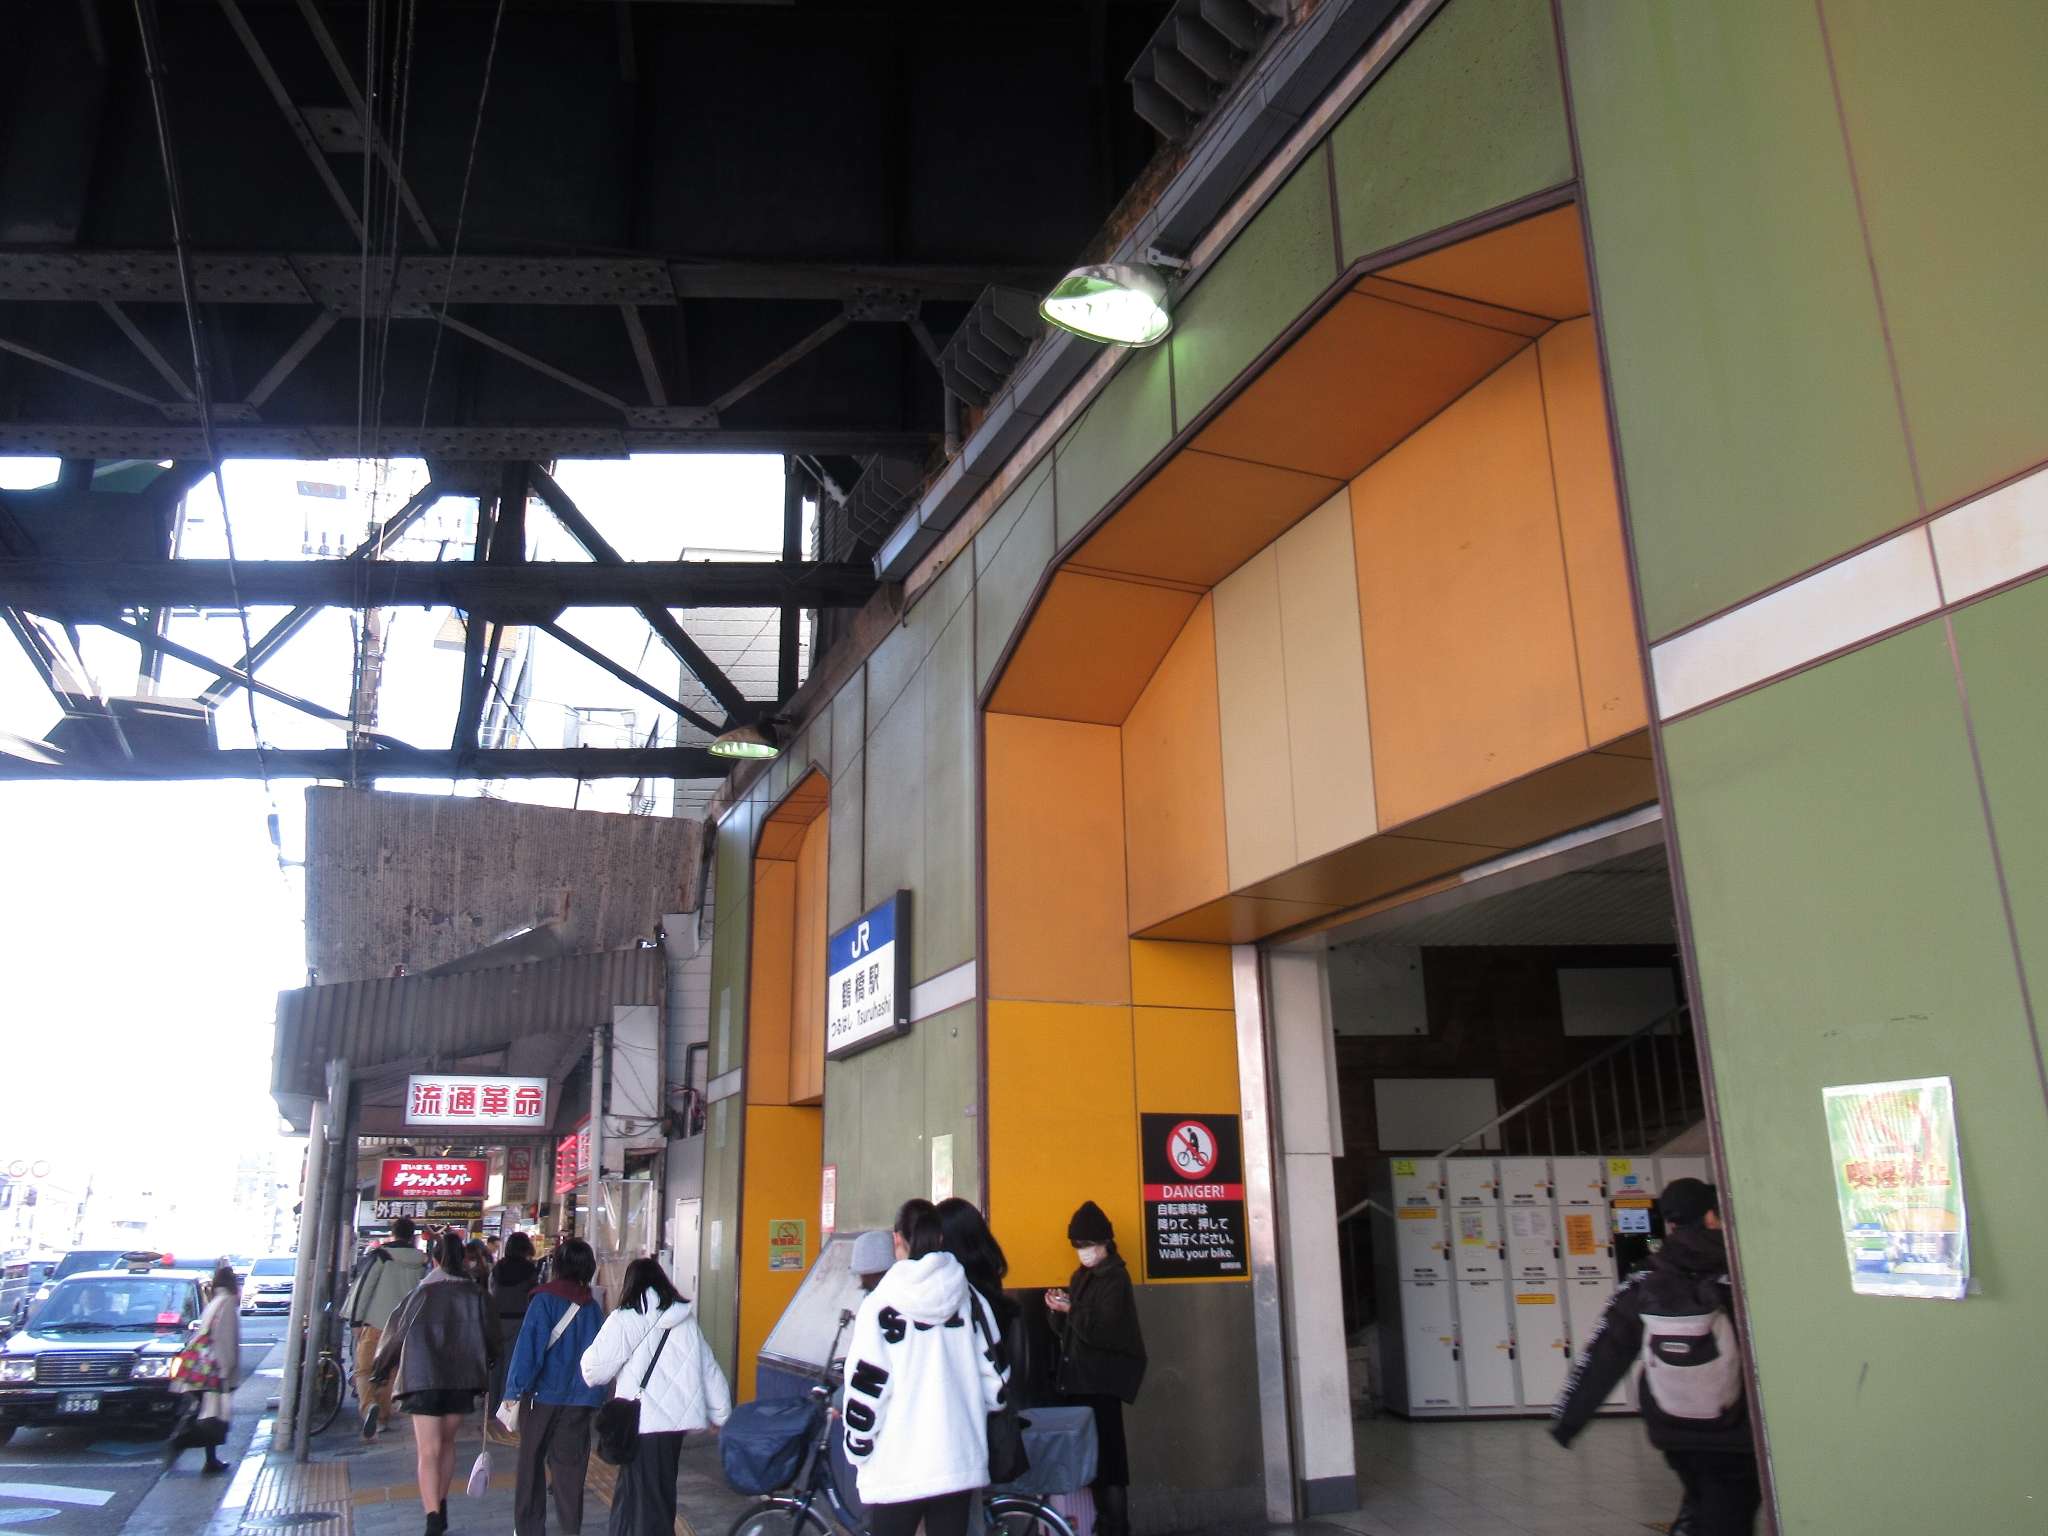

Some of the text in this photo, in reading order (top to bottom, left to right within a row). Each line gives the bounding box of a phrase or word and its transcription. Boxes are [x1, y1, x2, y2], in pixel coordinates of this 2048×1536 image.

[851, 920, 870, 959] JR
[412, 1084, 543, 1116] 流通革命
[393, 1172, 472, 1187] チケットスーパー
[1163, 1185, 1224, 1199] DANGER!
[1157, 1203, 1209, 1216] 自転車等は
[1157, 1217, 1229, 1230] 降りて、押して
[1159, 1233, 1234, 1246] ご通行ください。
[1159, 1247, 1234, 1261] Walk your bike.
